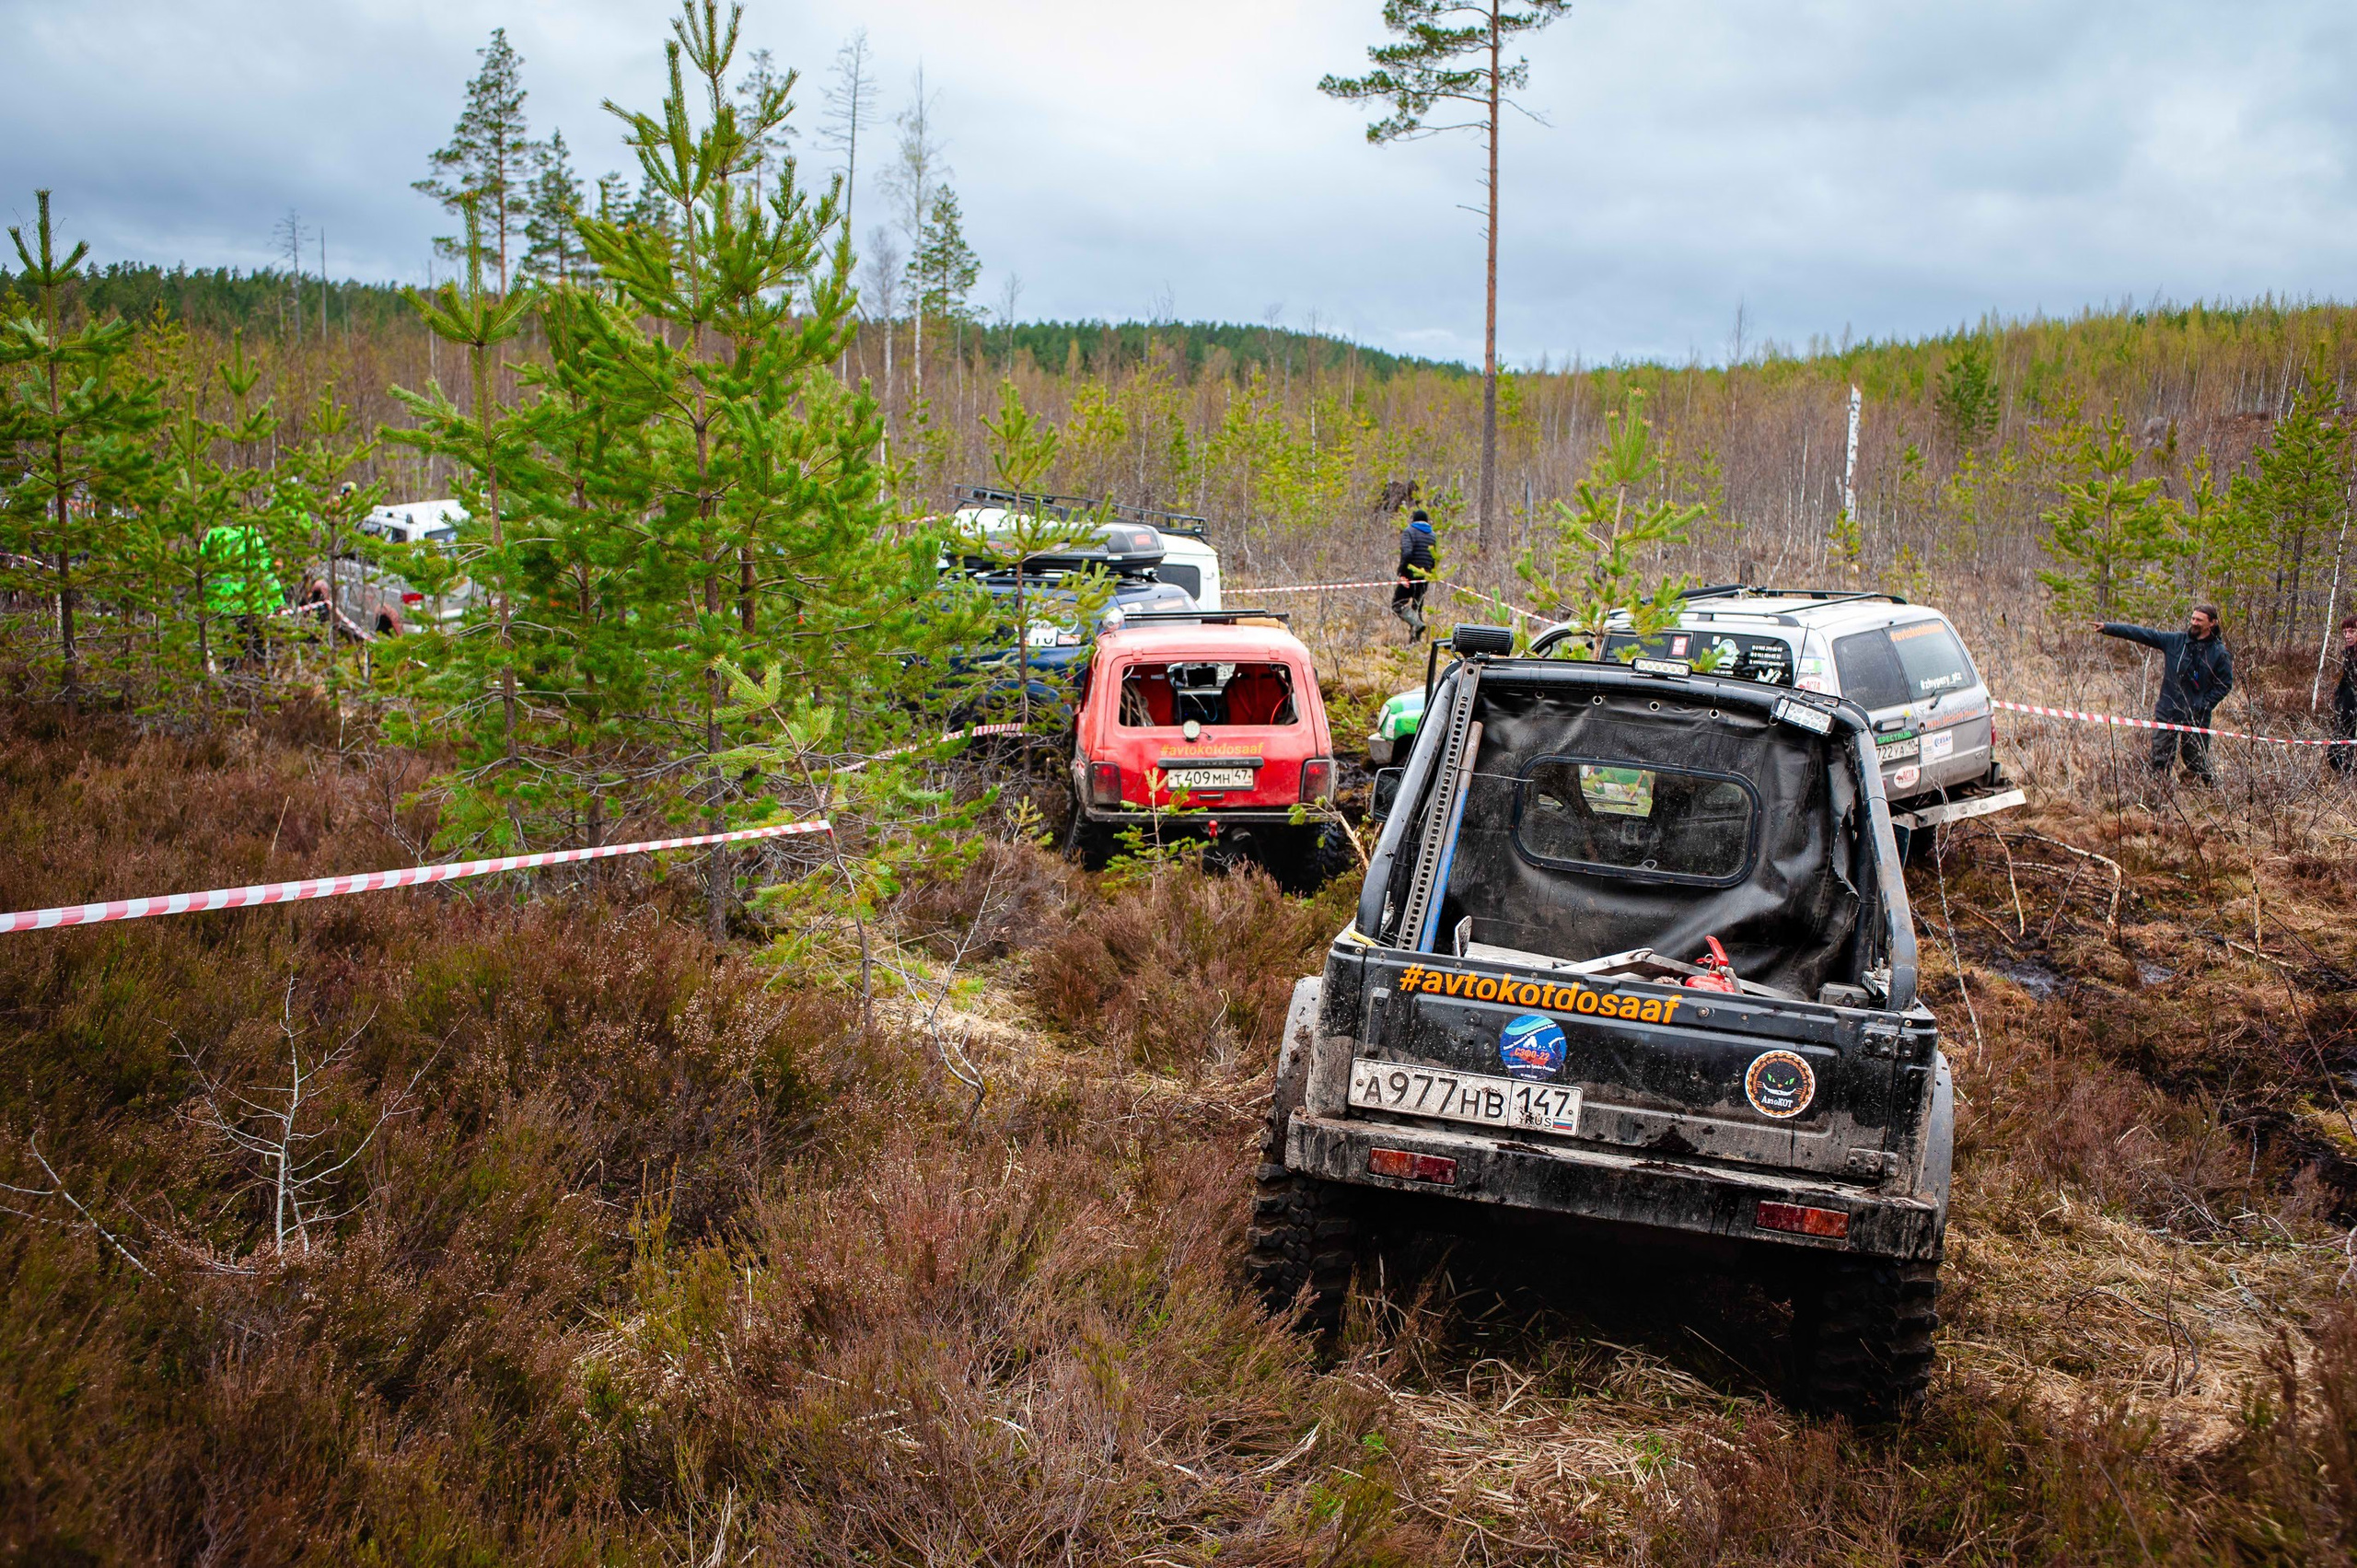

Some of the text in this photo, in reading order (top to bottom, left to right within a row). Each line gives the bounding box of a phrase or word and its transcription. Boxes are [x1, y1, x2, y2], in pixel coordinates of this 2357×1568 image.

[1877, 730, 1912, 744] SPECTRUM
[1160, 742, 1264, 756] #avtokotdosaaf
[1875, 745, 1904, 760] 722УА
[1235, 769, 1248, 781] 47
[1399, 963, 1682, 1024] #avtokotdosaaf
[1516, 1086, 1571, 1117] 147
[1525, 1114, 1551, 1127] RUS
